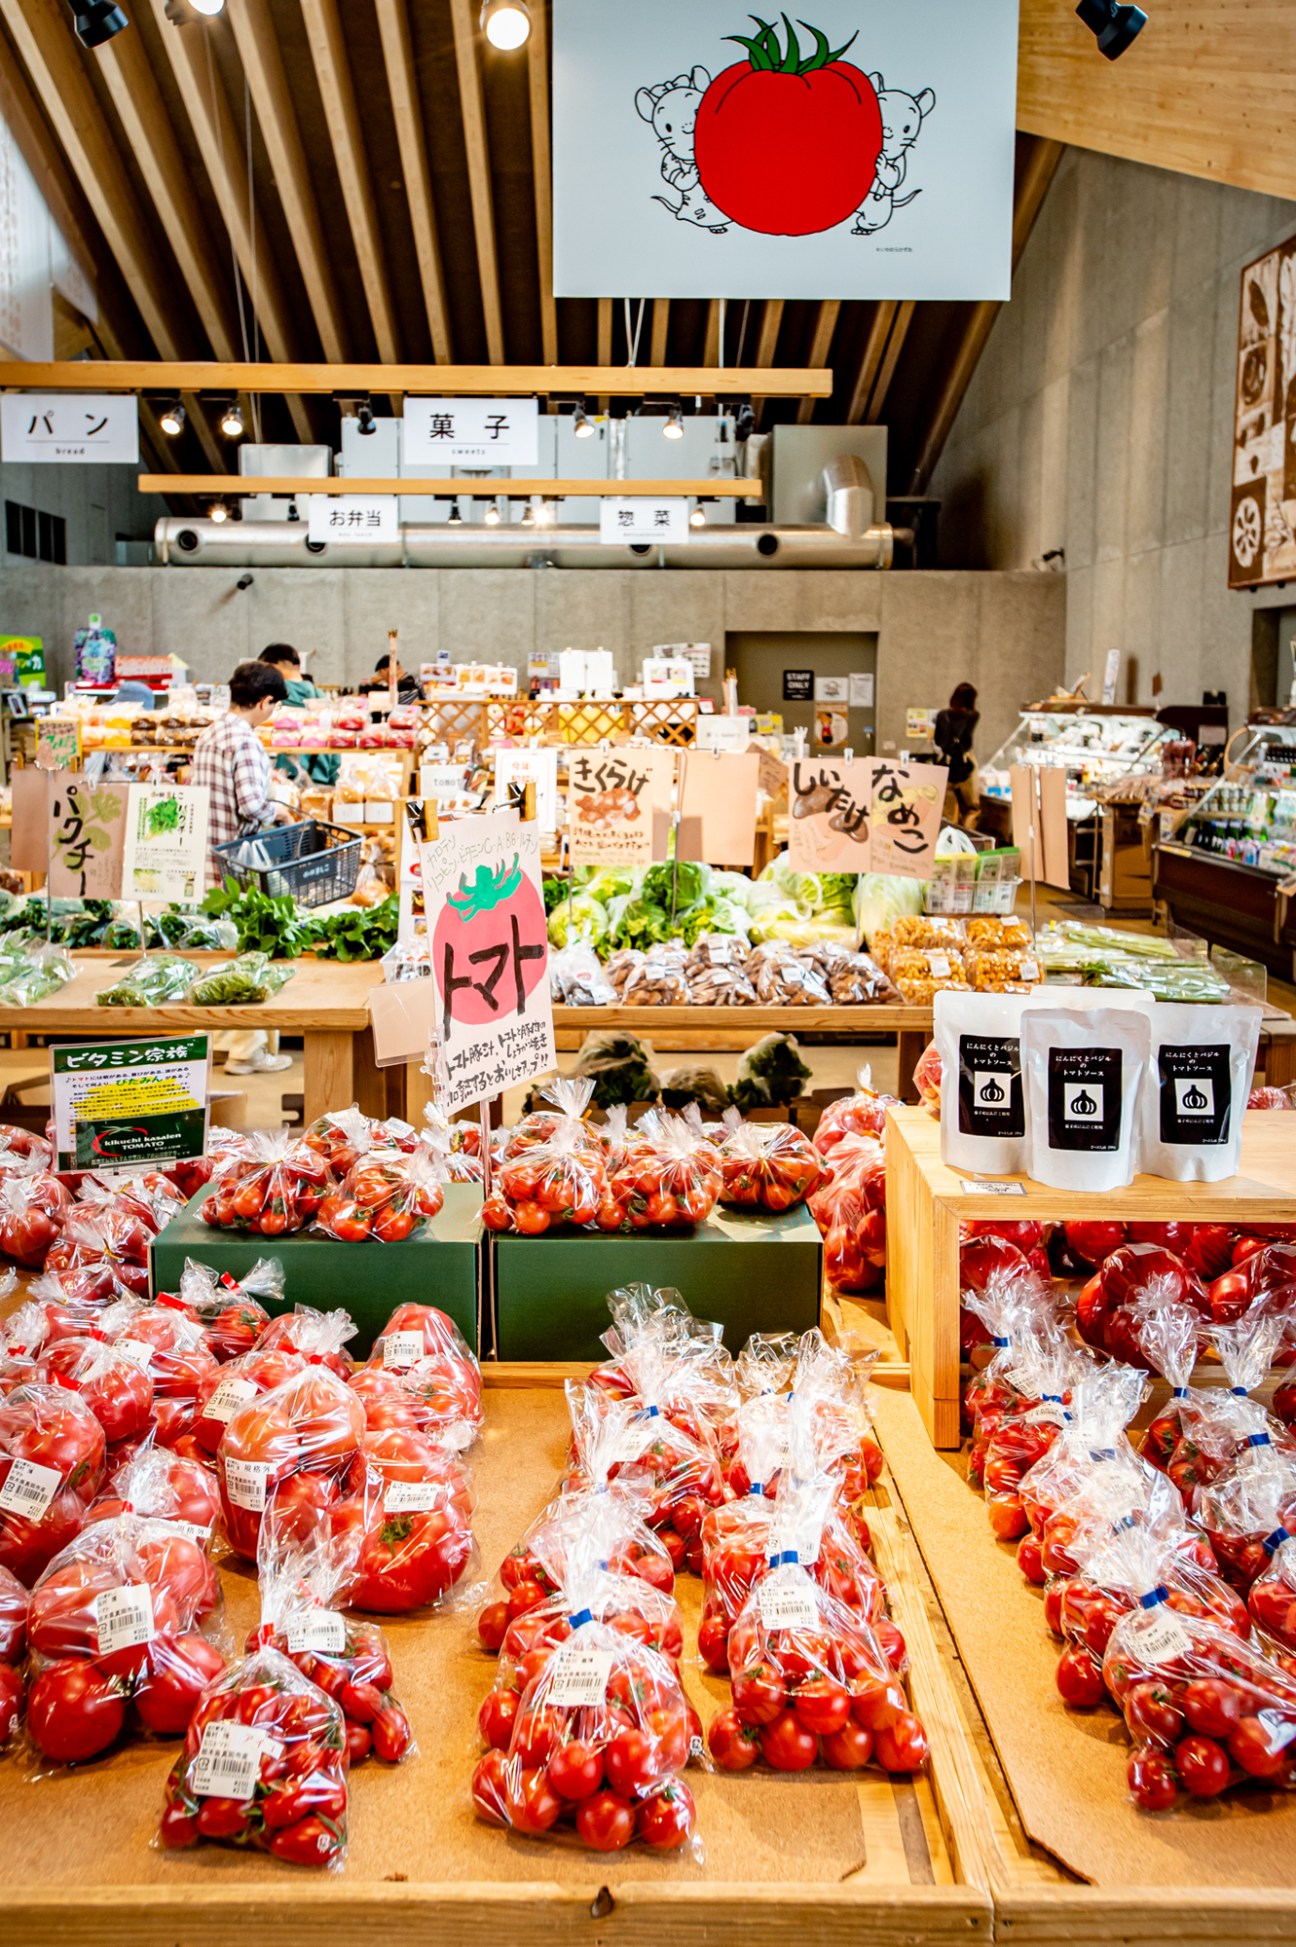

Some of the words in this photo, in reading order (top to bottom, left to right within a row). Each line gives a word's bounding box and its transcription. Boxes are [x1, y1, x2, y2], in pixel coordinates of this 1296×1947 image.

[28, 409, 108, 435] パン
[429, 413, 510, 440] 菓子
[55, 447, 85, 455] bread
[329, 509, 381, 527] お弁当
[618, 509, 671, 527] 惣菜
[787, 681, 810, 689] ONLY
[573, 756, 653, 796] きくらげ
[793, 762, 870, 832] しいたけ
[872, 764, 929, 854] なめこ
[53, 785, 95, 897] パクチー
[442, 914, 545, 1042] トマト
[66, 1044, 189, 1068] ビタミン家族
[966, 1042, 1019, 1052] にんにくとバジル
[1165, 1051, 1220, 1059] にんにくとバジル
[973, 1057, 1013, 1066] トマトソース
[1063, 1069, 1105, 1077] トマトソース
[104, 1137, 141, 1147] kikuchi
[143, 1133, 182, 1142] kasaien
[122, 1141, 165, 1150] TOMATO
[244, 1464, 271, 1473] 規格外
